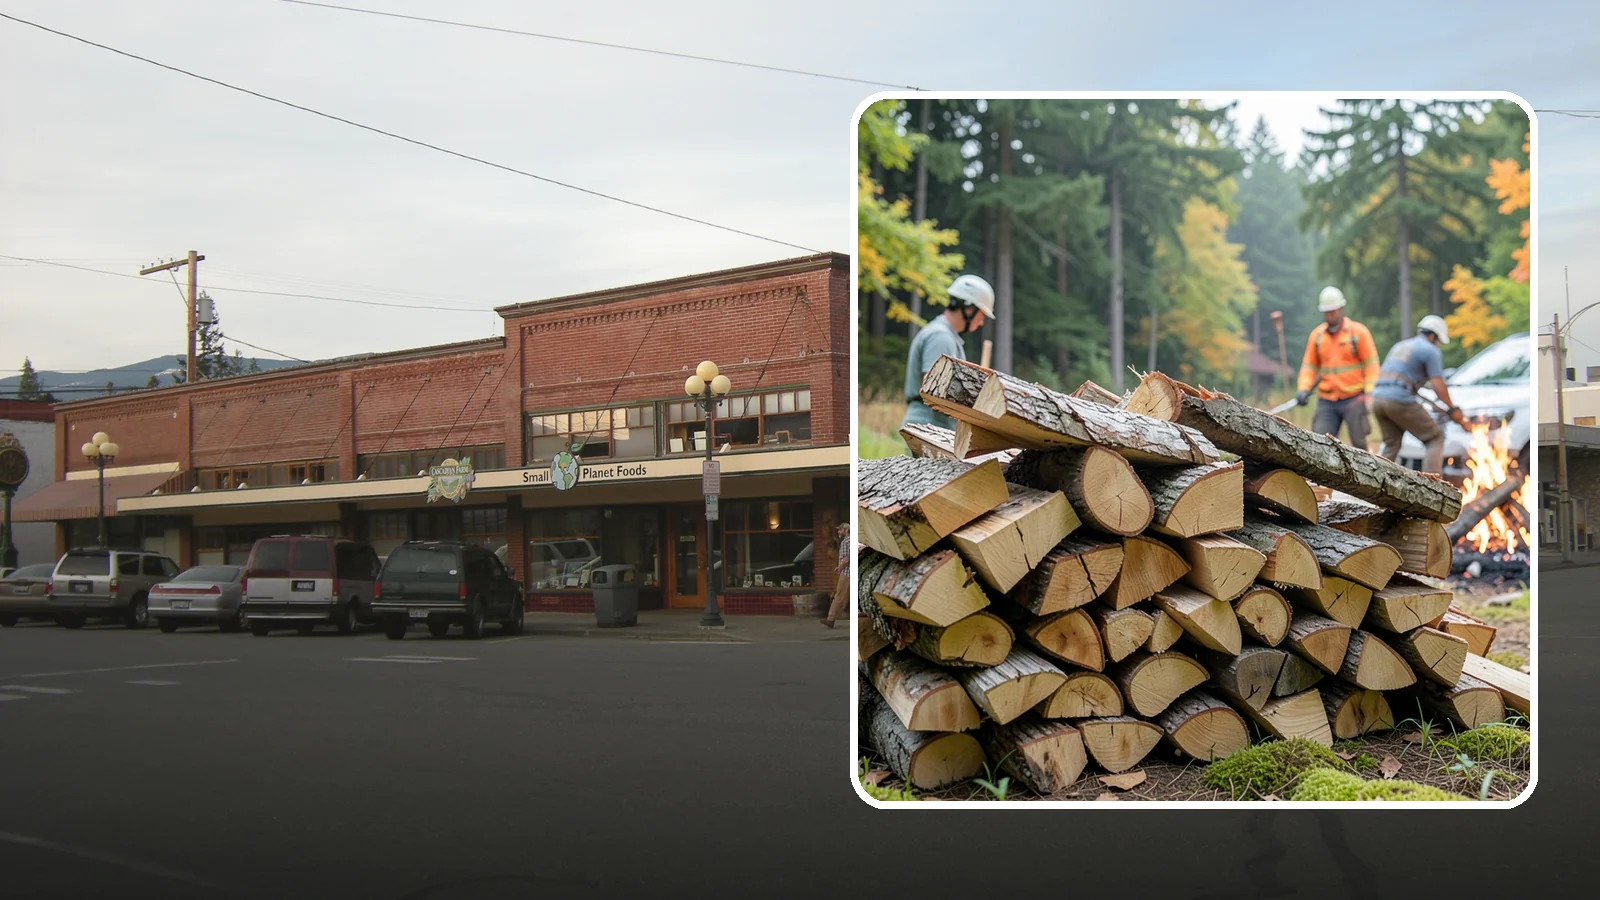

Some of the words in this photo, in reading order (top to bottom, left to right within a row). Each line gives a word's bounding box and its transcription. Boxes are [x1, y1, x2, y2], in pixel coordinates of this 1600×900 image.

[522, 471, 548, 482] Small
[583, 466, 614, 479] Planet
[617, 464, 647, 476] Foods
